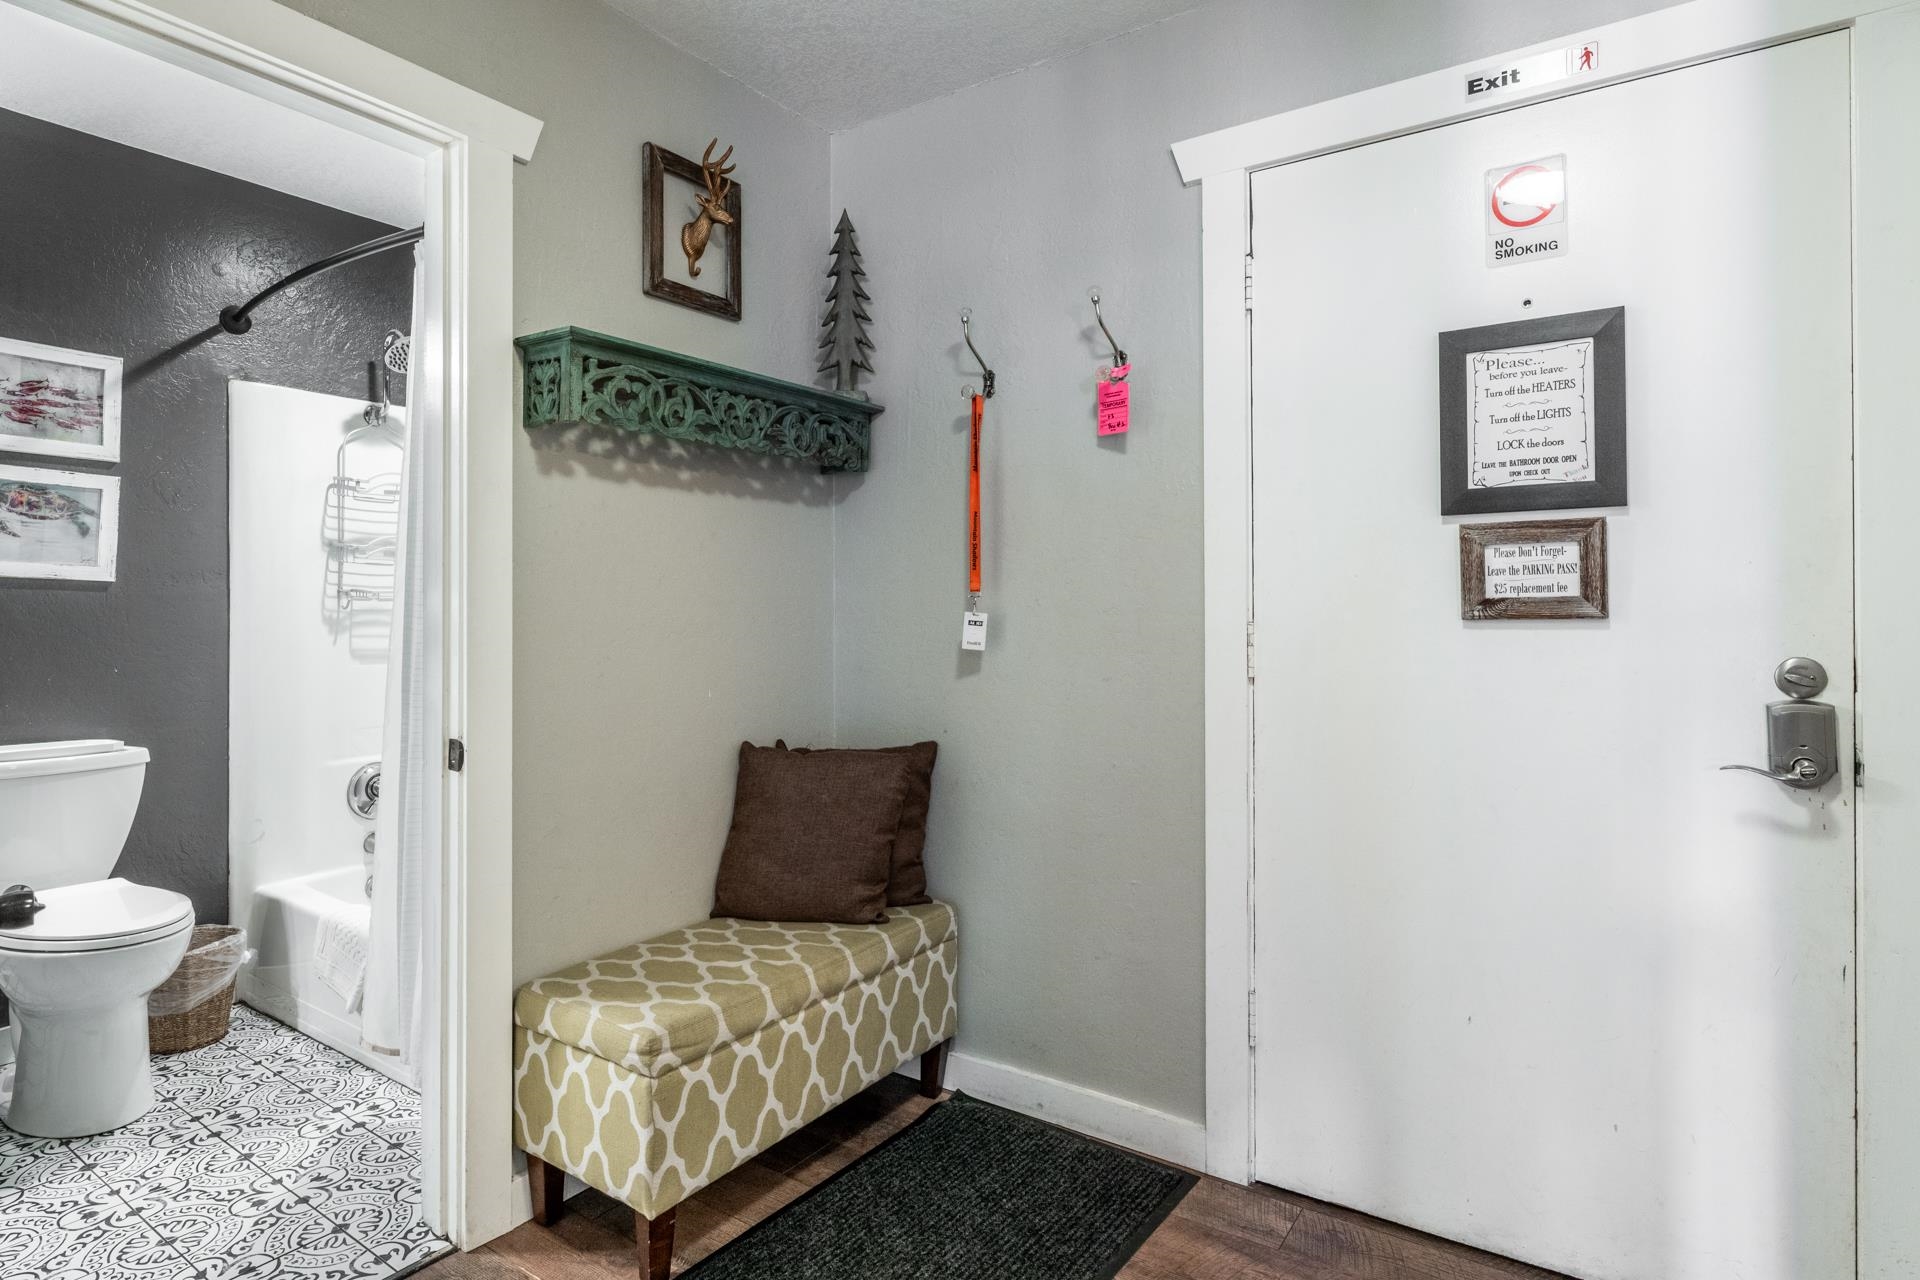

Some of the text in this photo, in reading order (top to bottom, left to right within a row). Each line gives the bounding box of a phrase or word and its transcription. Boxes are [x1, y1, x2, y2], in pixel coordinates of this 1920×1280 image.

[1467, 68, 1520, 96] Exit
[1495, 238, 1514, 250] NO
[1495, 240, 1559, 260] SMOKING
[1486, 358, 1545, 371] Please...
[1489, 366, 1568, 380] before you leave-
[1484, 378, 1576, 398] Turn off the HEATERS
[1489, 407, 1572, 424] Turn off the LIGHTS
[1497, 437, 1564, 450] LOCK the doors
[1509, 457, 1540, 466] BATHROOM
[1542, 456, 1559, 464] DOOR
[1561, 454, 1577, 463] OPEN
[1494, 547, 1516, 558] Please
[1518, 546, 1538, 557] Don't
[1487, 563, 1578, 576] Leave the PARKING PASS!
[1494, 582, 1568, 596] $25 replacement fee
